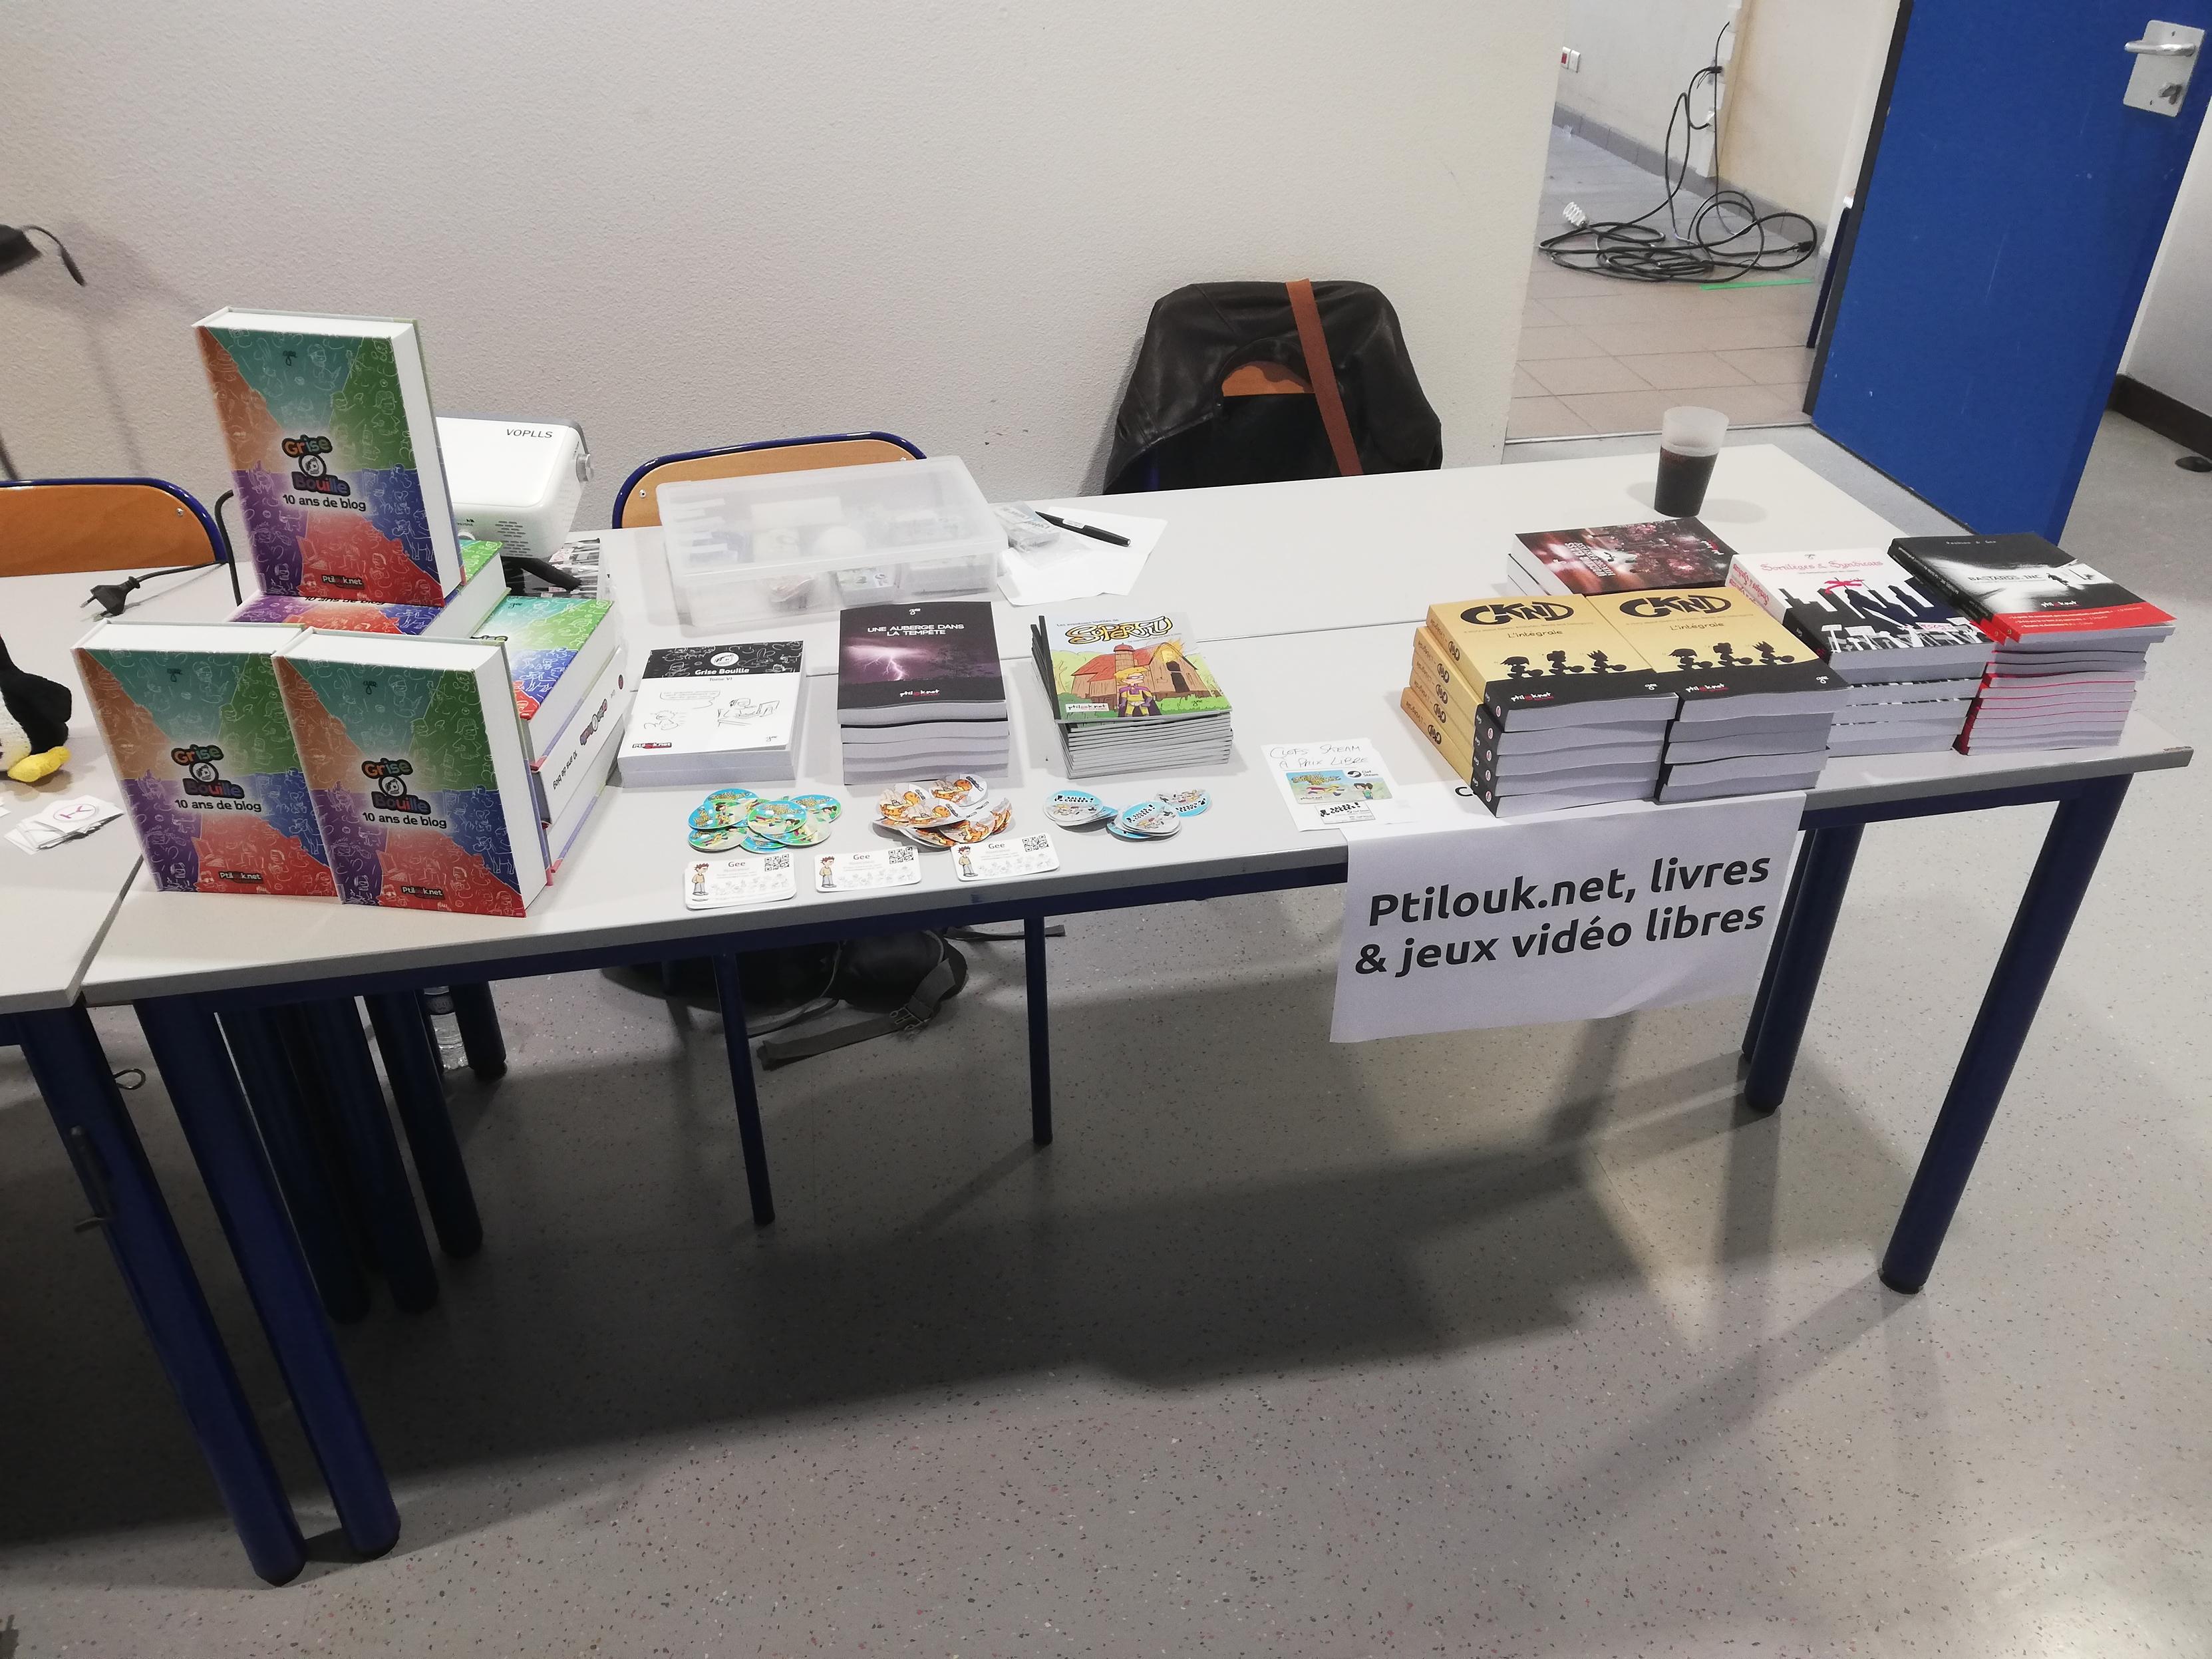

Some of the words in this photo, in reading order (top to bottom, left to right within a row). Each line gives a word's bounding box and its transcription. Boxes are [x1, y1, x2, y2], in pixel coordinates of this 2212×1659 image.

[506, 428, 553, 438] VOPLLS
[283, 436, 331, 456] Grise
[293, 473, 349, 495] Bouille
[283, 494, 295, 504] 10
[299, 497, 320, 507] ans
[323, 497, 338, 508] de
[341, 498, 366, 512] blog
[323, 575, 363, 585] Ptilk.net
[1460, 601, 1574, 625] GKND
[1619, 595, 1732, 617] GKND
[1670, 622, 1724, 631] L'intégrale
[1686, 683, 1725, 692] ptilk.net
[1511, 692, 1551, 702] ptilk.net
[174, 745, 222, 763] Grise
[1320, 744, 1360, 754] STEAM
[364, 760, 412, 777] Grise
[1299, 758, 1323, 768] PRIX
[1331, 756, 1368, 766] LIBRE
[184, 780, 244, 798] Bouille
[175, 800, 188, 809] 10
[192, 801, 213, 810] ans
[217, 800, 232, 810] de
[235, 800, 261, 812] blog
[373, 793, 430, 814] Bouille
[363, 813, 375, 822] 10
[379, 815, 400, 824] ans
[403, 814, 417, 826] de
[420, 816, 447, 829] blog
[402, 886, 443, 896] Ptilk.net
[1368, 868, 1637, 927] Ptilouk.net,
[1650, 856, 1771, 893] livres
[1354, 943, 1387, 975] &
[1394, 937, 1498, 978] jeux
[1512, 915, 1631, 959] vidéo
[1645, 905, 1766, 942] libres
